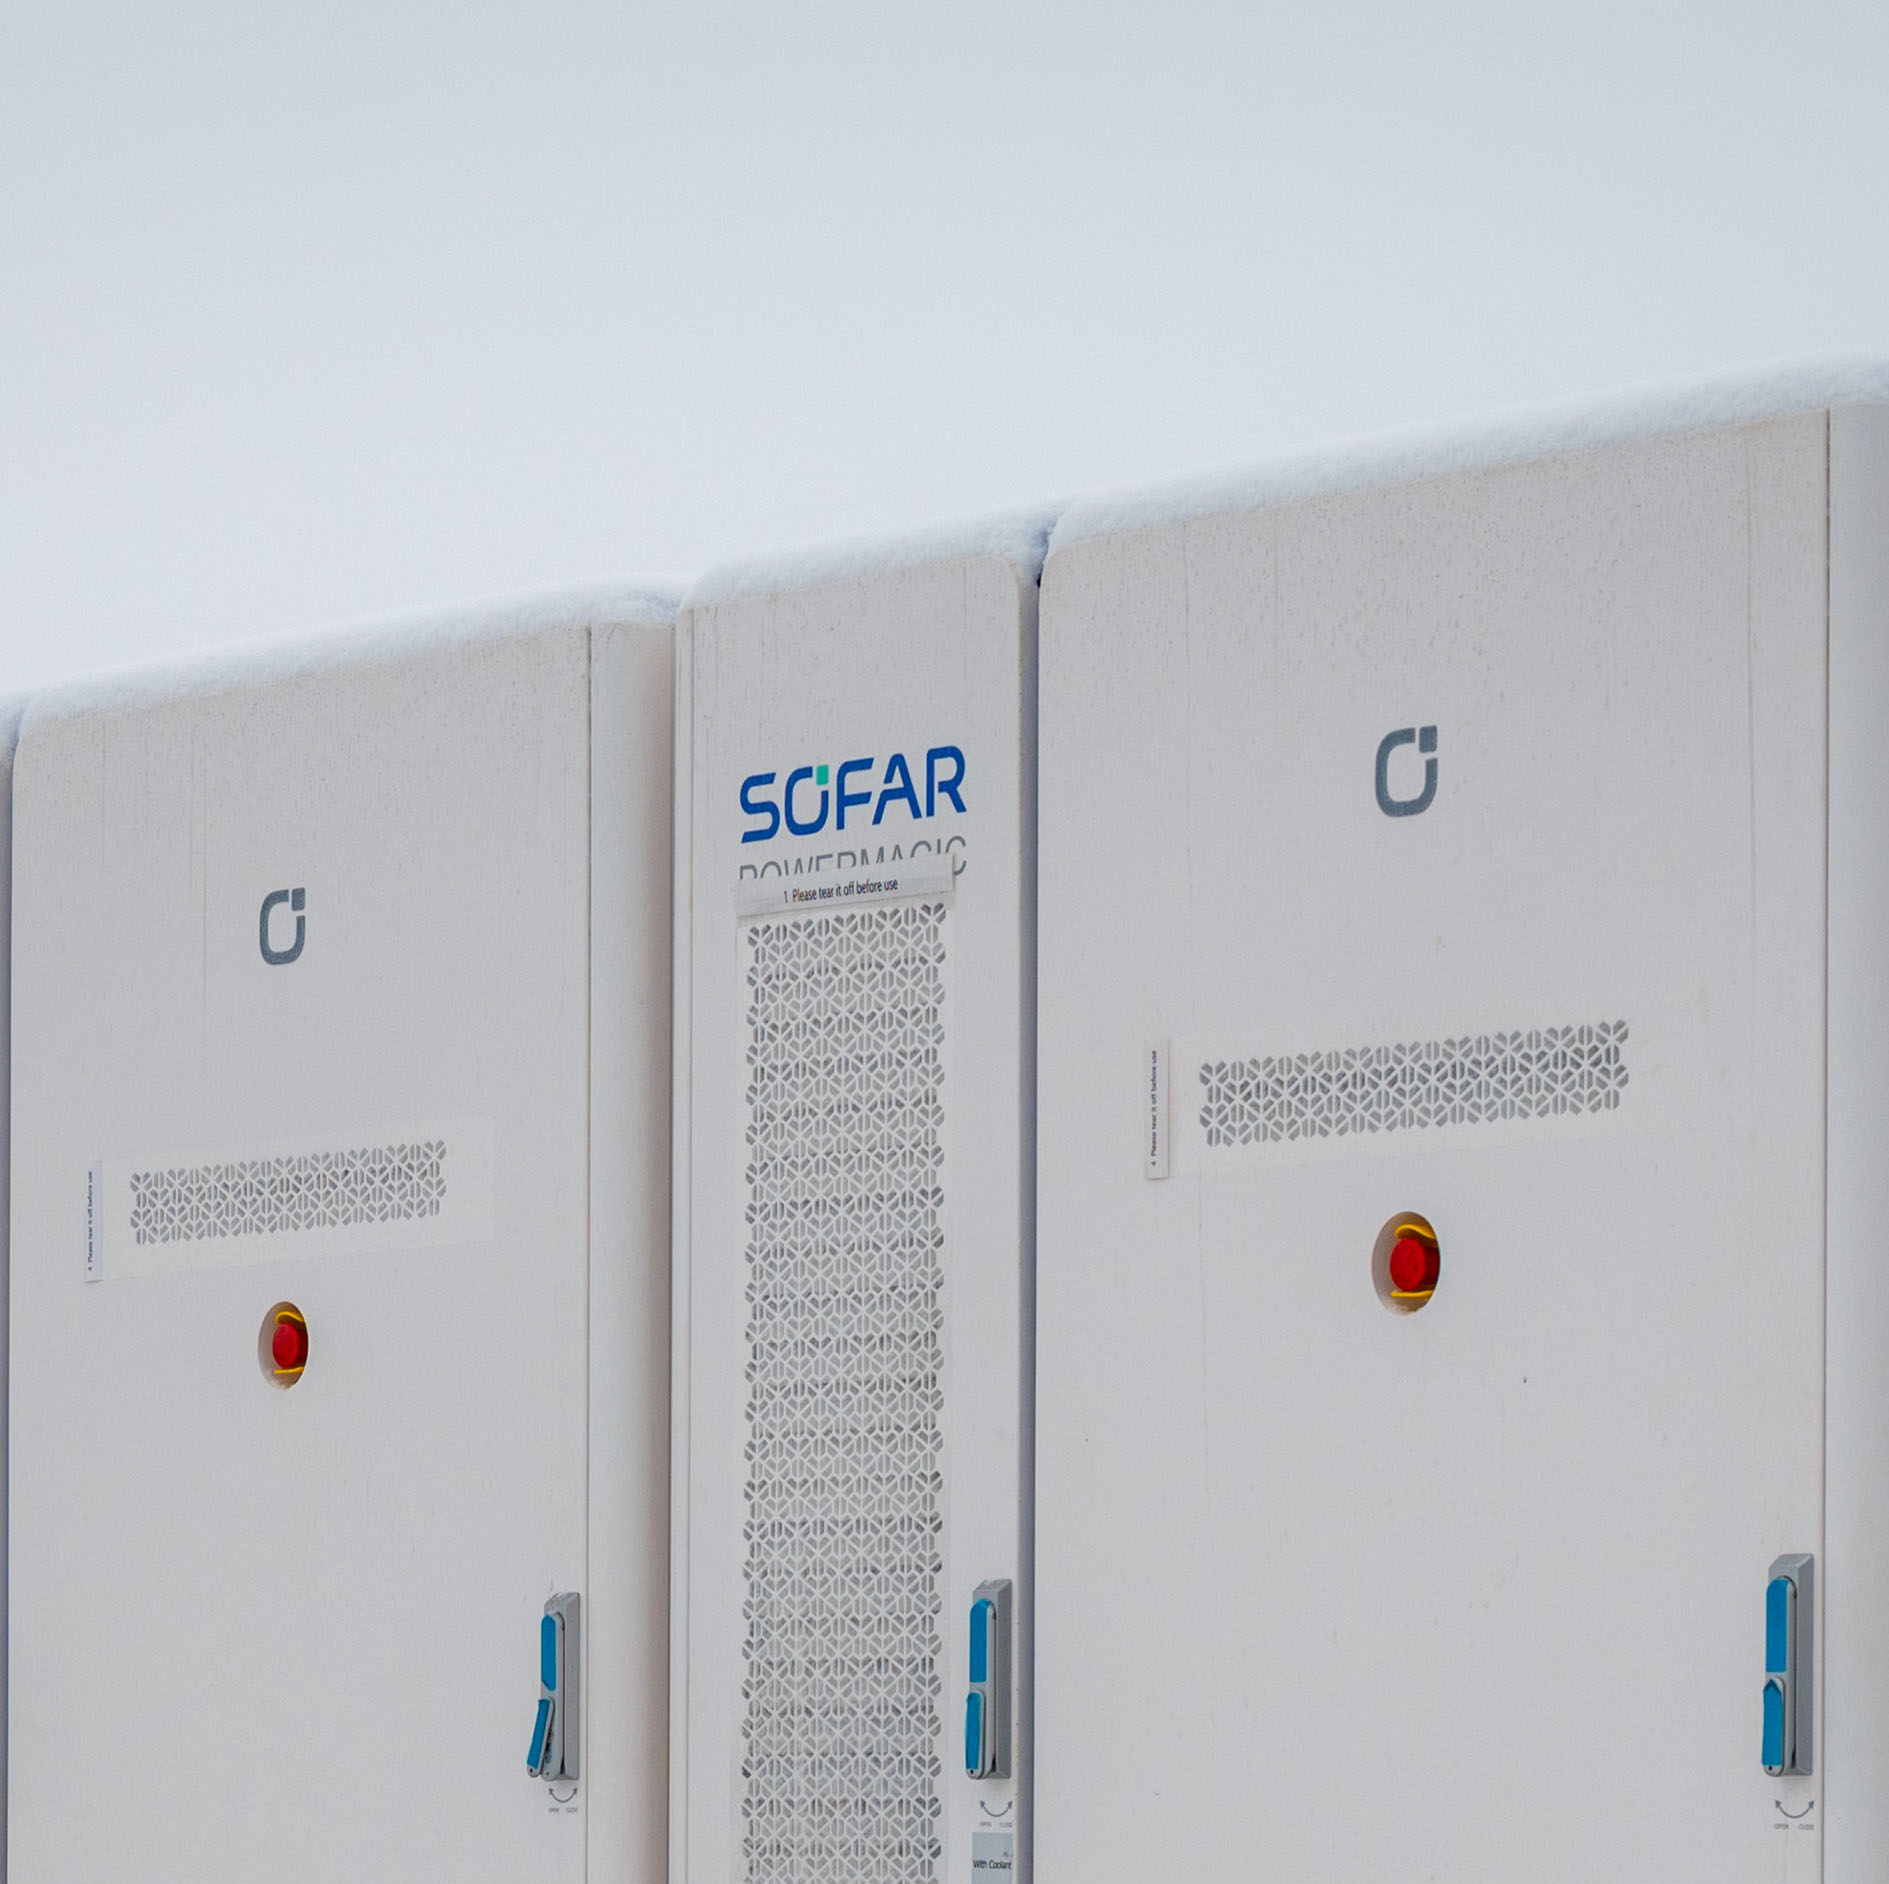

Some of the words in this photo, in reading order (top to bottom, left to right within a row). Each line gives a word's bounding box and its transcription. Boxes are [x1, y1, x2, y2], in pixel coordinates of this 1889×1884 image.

[739, 745, 967, 844] SOFAR
[792, 888, 817, 903] Please
[818, 887, 834, 900] tear
[835, 883, 842, 897] it
[843, 881, 855, 896] off
[856, 879, 883, 895] before
[884, 879, 898, 892] use
